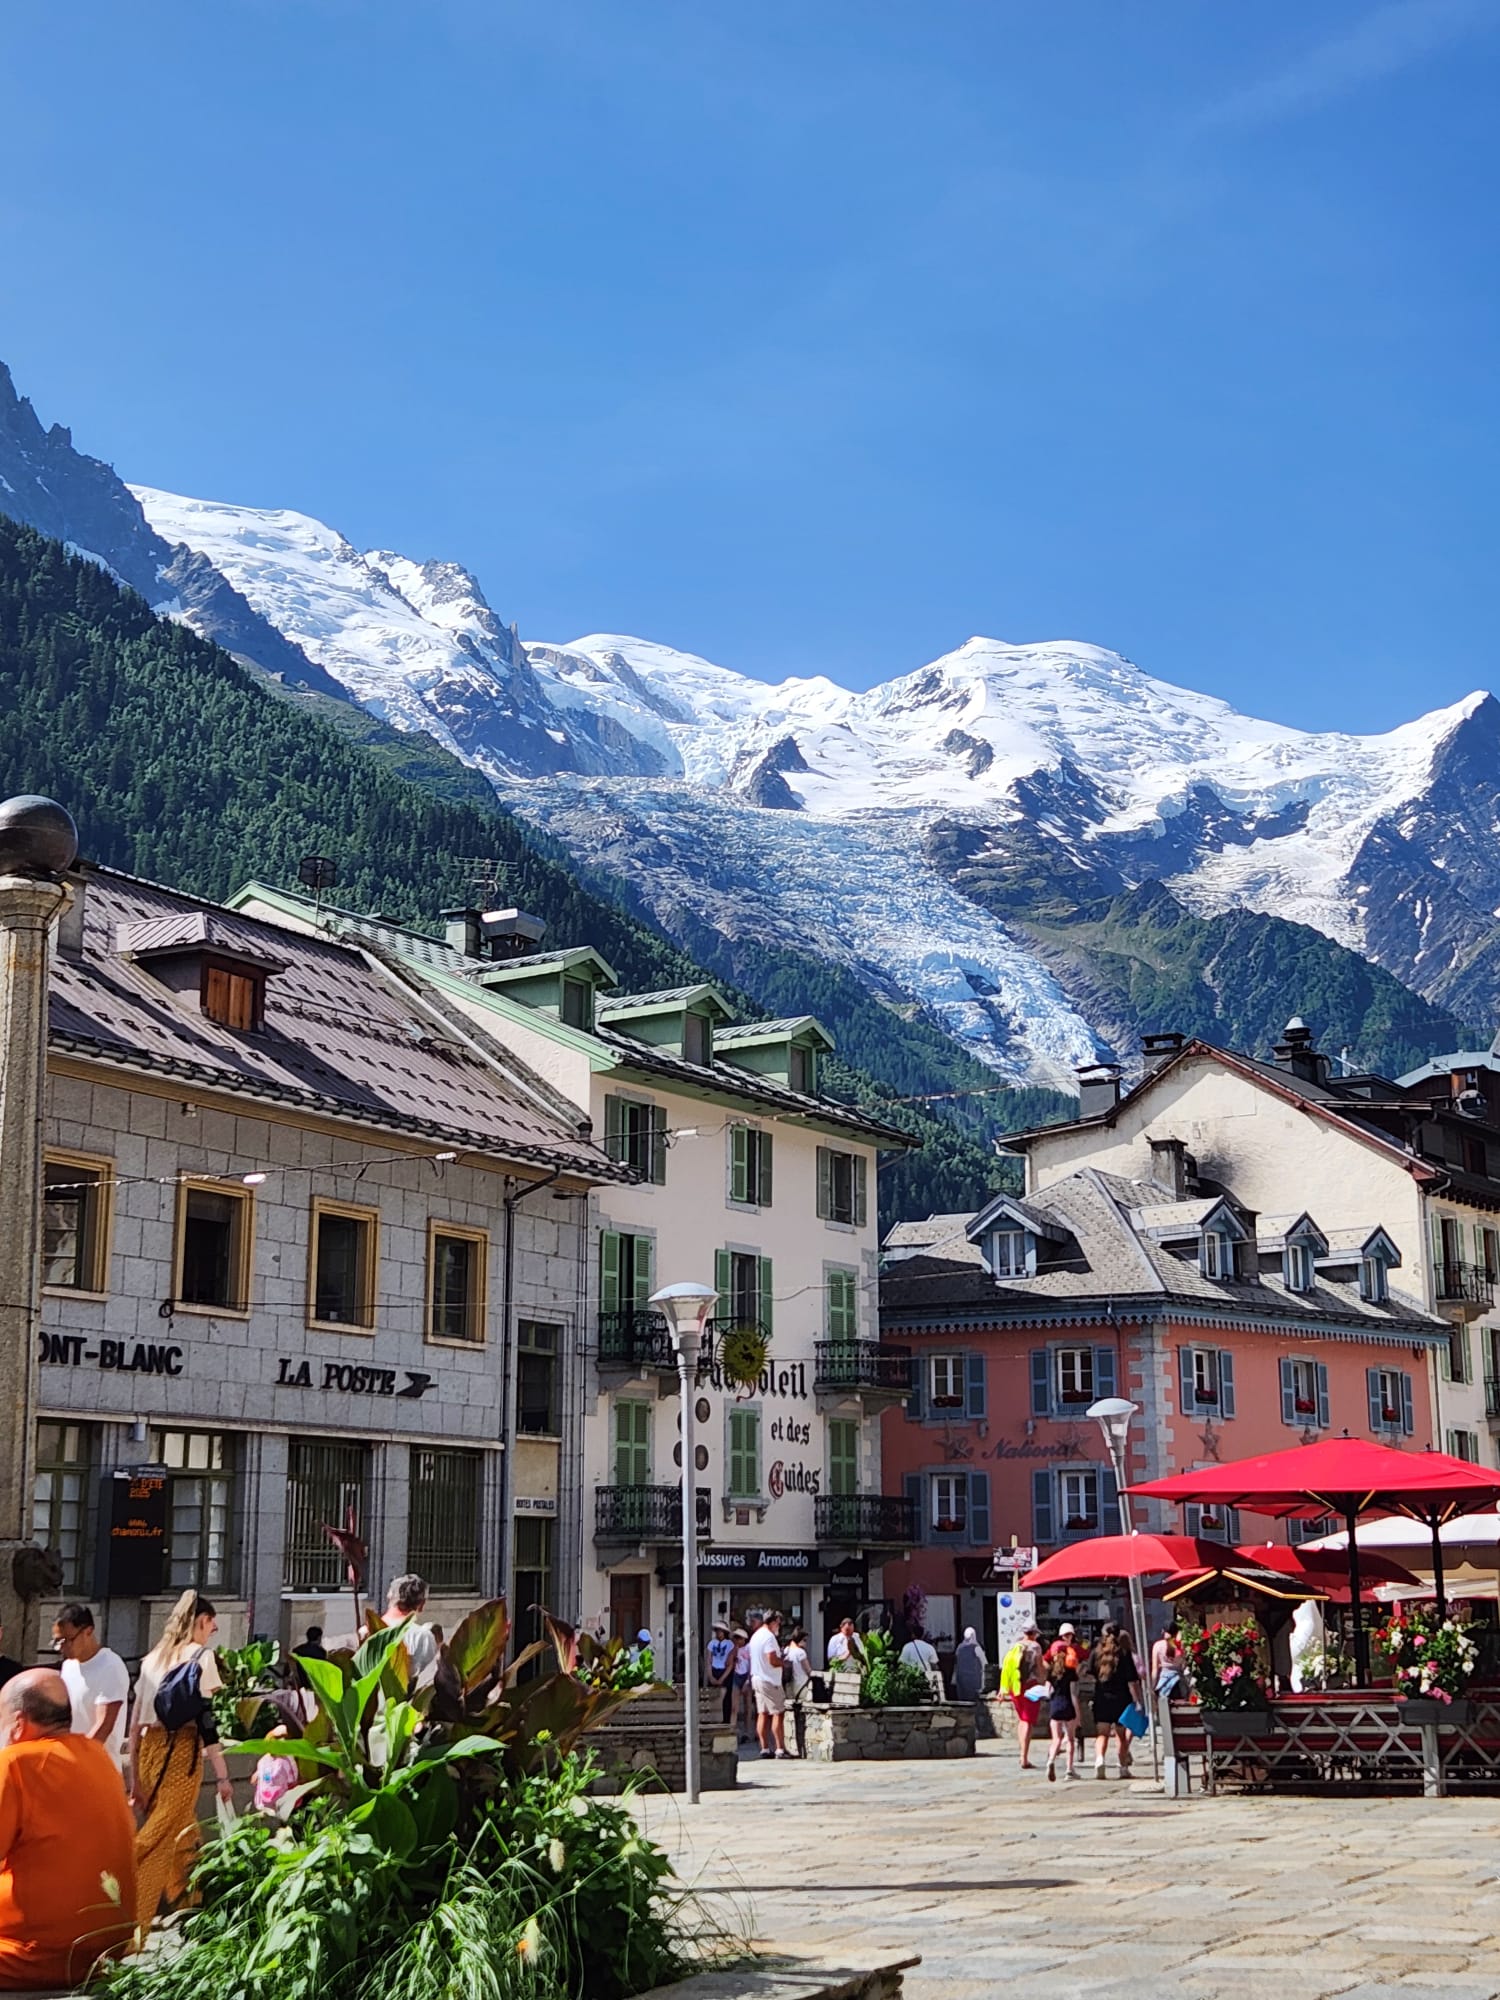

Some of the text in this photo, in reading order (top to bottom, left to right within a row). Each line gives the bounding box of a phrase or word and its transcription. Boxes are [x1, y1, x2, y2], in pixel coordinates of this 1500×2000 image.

[275, 1358, 396, 1395] LA POSTE
[771, 1416, 811, 1445] et des
[768, 1460, 822, 1500] Guides
[758, 1551, 809, 1568] Armando
